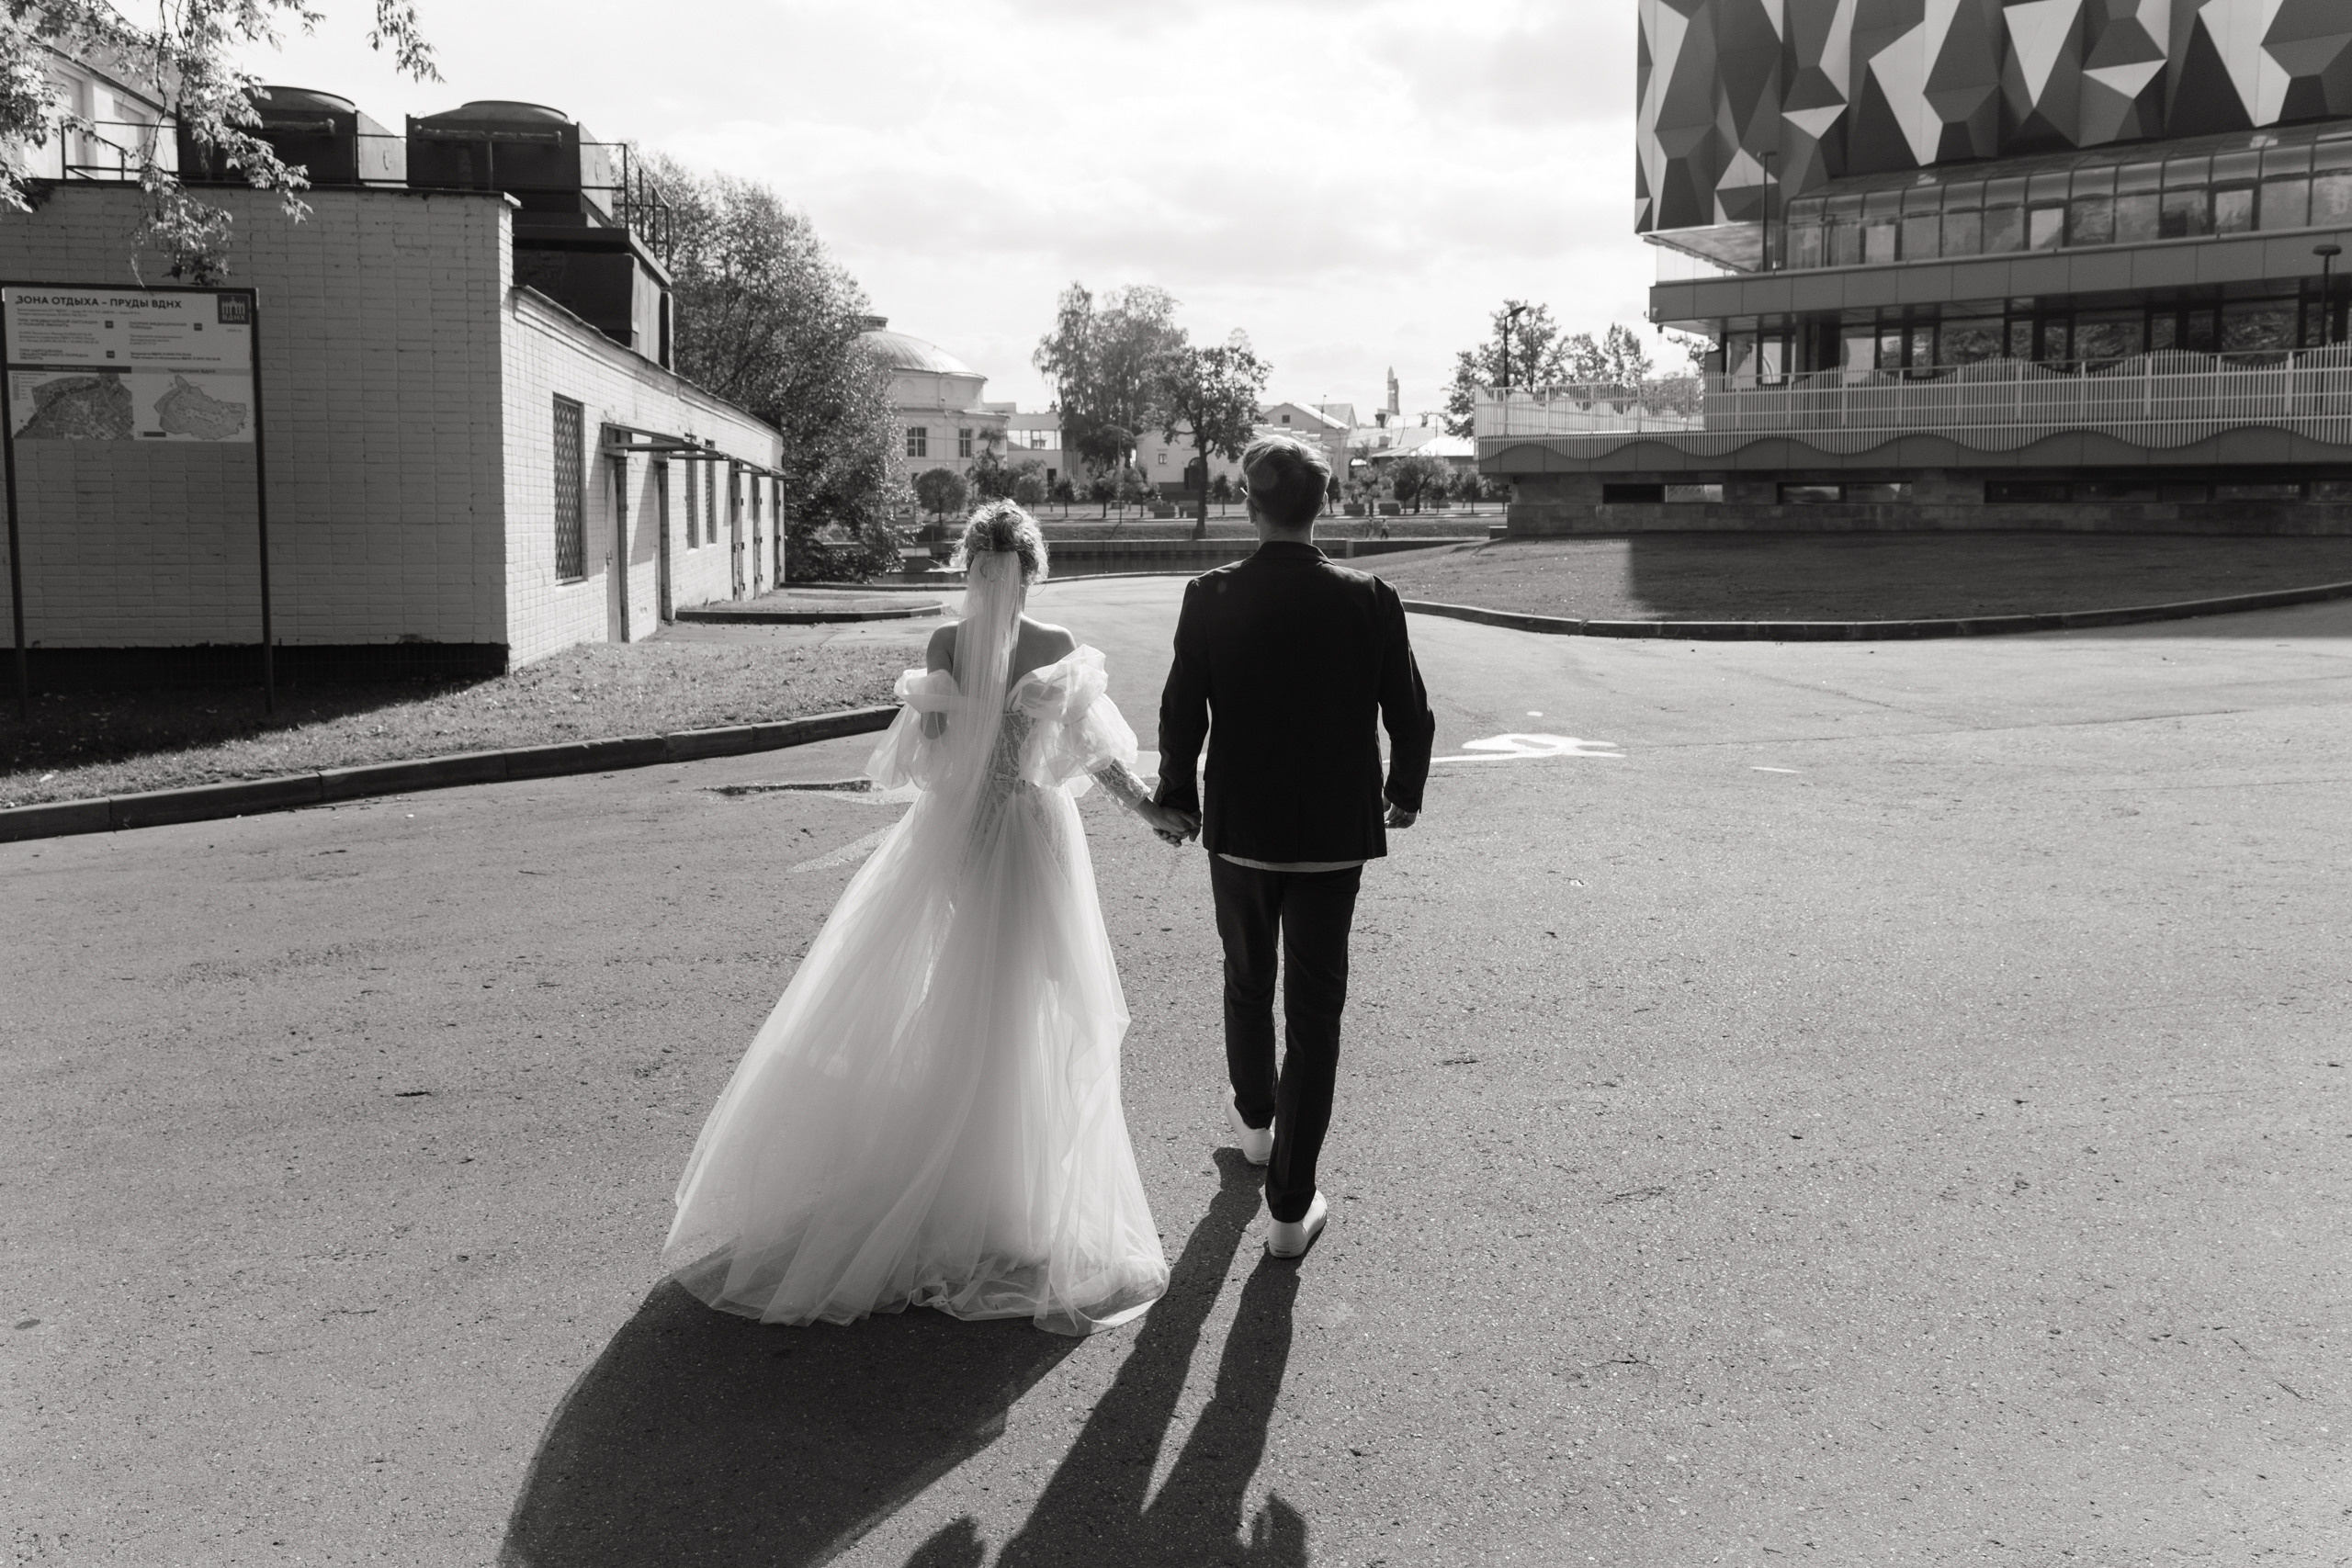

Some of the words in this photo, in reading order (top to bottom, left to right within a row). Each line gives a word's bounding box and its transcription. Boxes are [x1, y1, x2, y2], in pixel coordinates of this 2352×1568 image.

[17, 295, 49, 305] ЗОНА
[51, 296, 99, 307] ОТДЫХА
[110, 298, 150, 310] ПРУДЫ
[152, 299, 182, 310] ВДНХ
